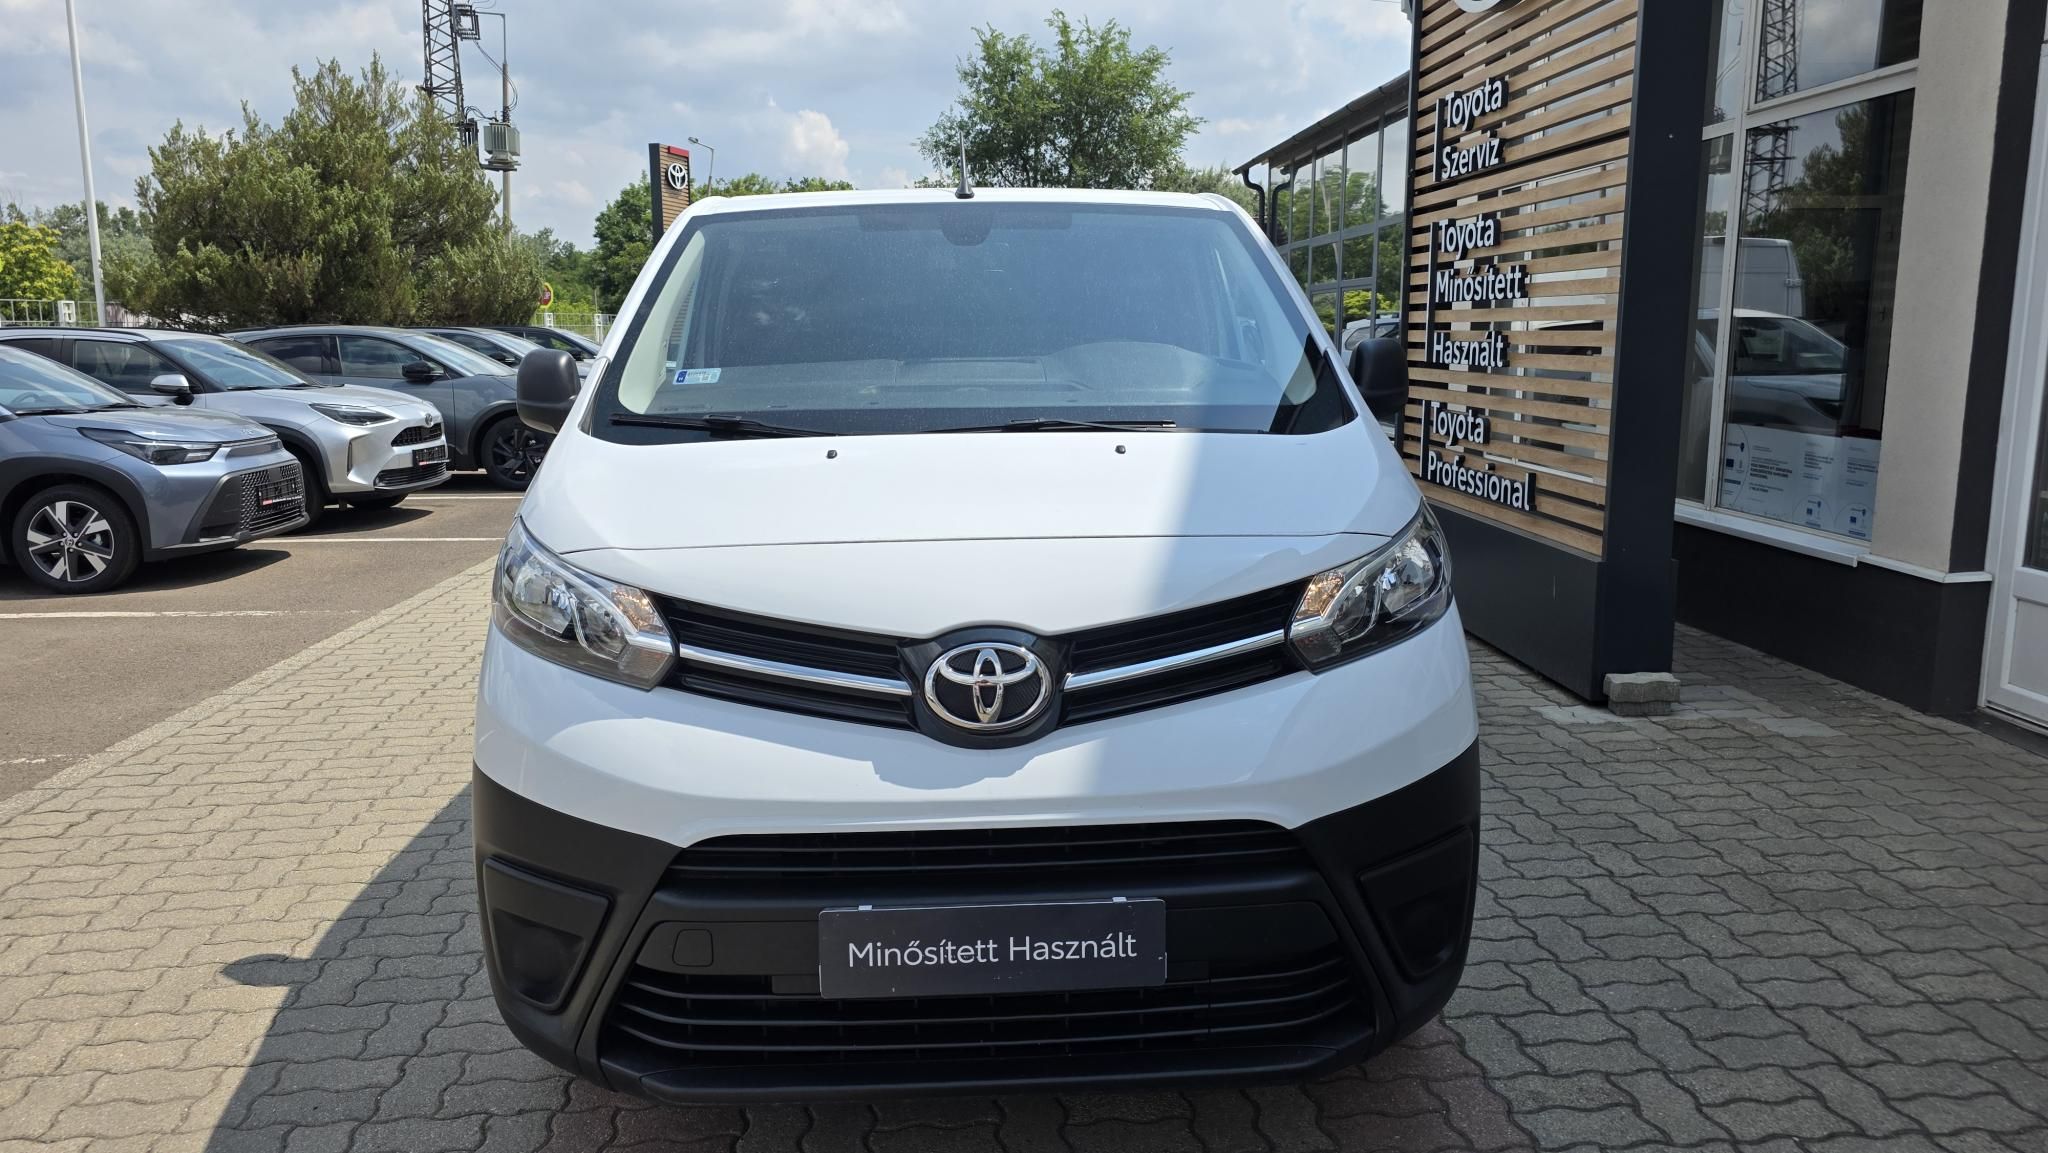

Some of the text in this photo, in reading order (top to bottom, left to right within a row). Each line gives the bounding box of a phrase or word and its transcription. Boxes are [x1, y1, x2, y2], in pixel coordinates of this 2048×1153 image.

[1445, 77, 1503, 132] Toyota
[1441, 130, 1500, 180] Szerviz
[1438, 213, 1495, 260] Toyota
[1435, 264, 1522, 303] Minősített
[1432, 330, 1504, 368] Használt
[1430, 401, 1484, 447] Toyota
[1427, 450, 1530, 511] Professional
[848, 931, 1138, 968] Minősített Használt
